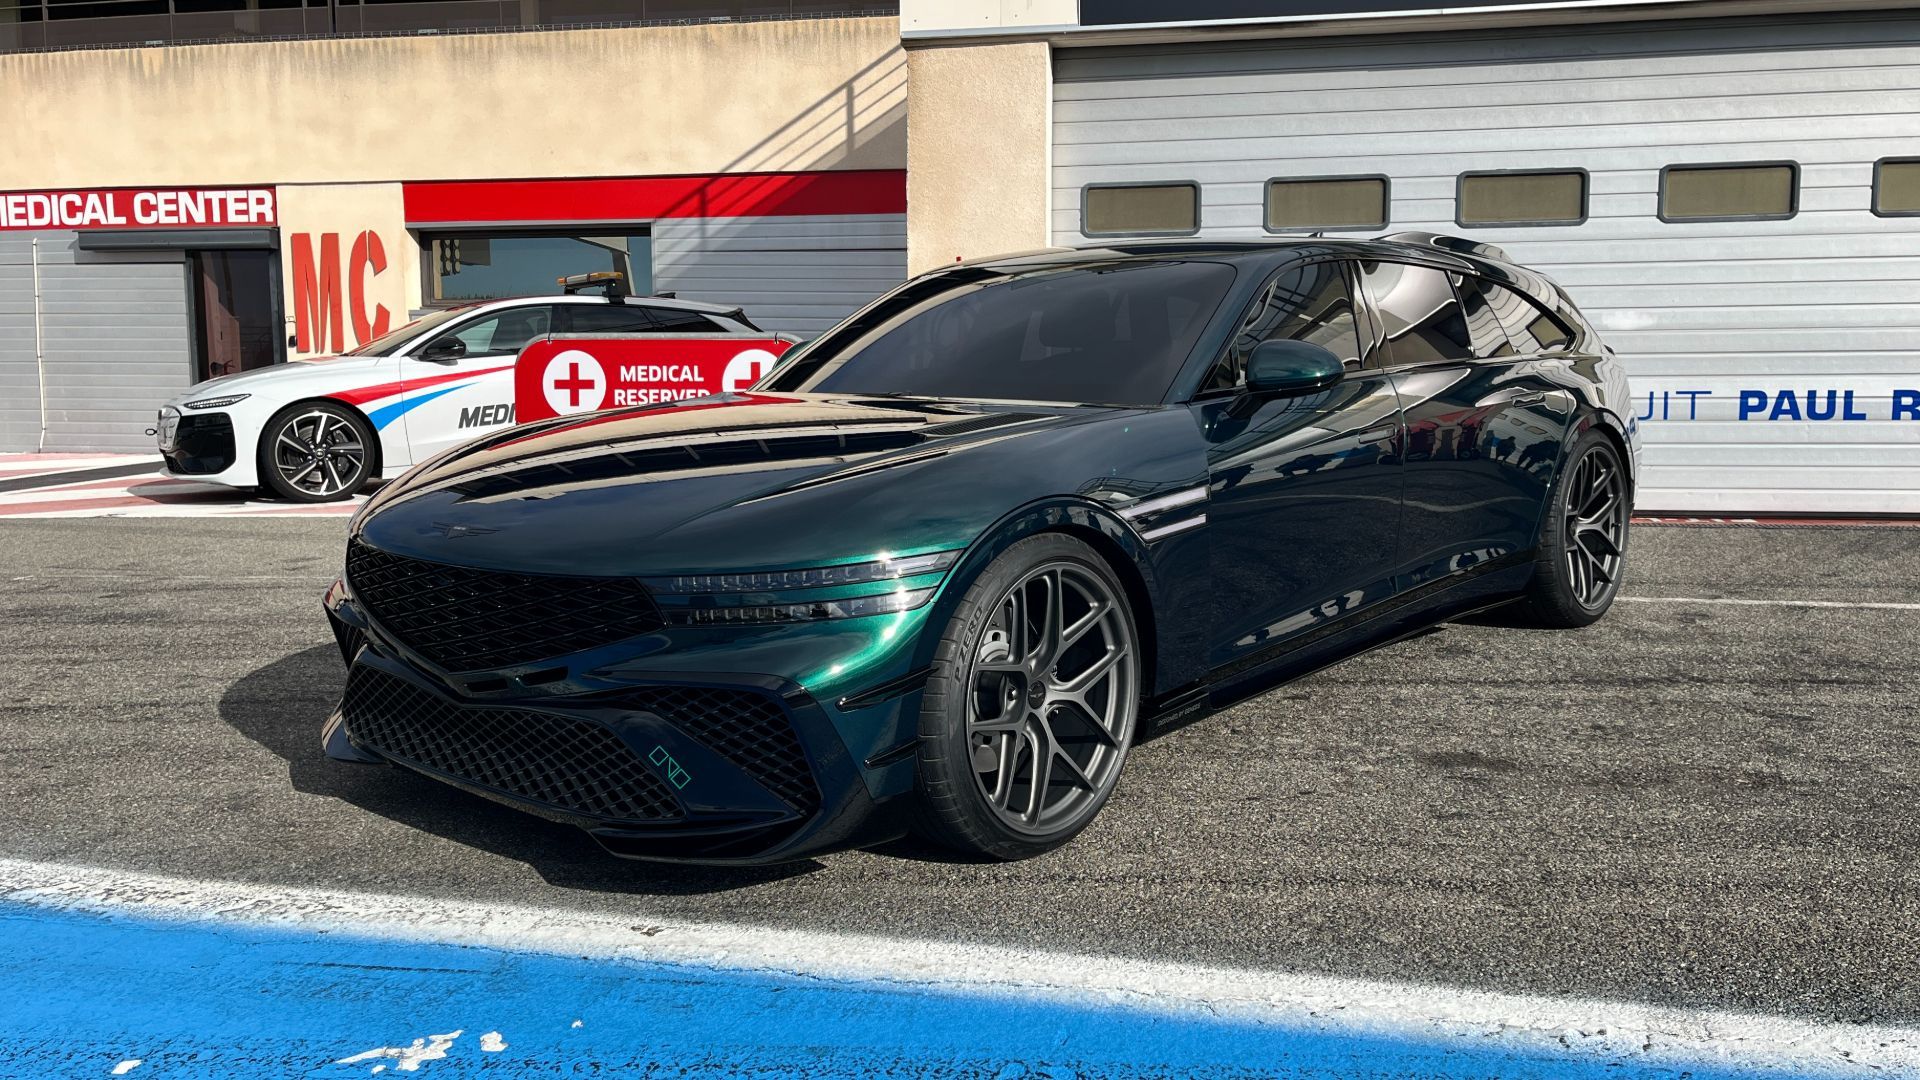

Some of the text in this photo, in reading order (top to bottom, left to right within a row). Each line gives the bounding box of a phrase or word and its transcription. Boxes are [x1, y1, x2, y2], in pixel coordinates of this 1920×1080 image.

[133, 189, 274, 224] CENTER
[290, 230, 391, 354] MC
[620, 365, 704, 382] MEDICAL
[1738, 389, 1867, 421] PAUL
[959, 605, 983, 665] ZERO
